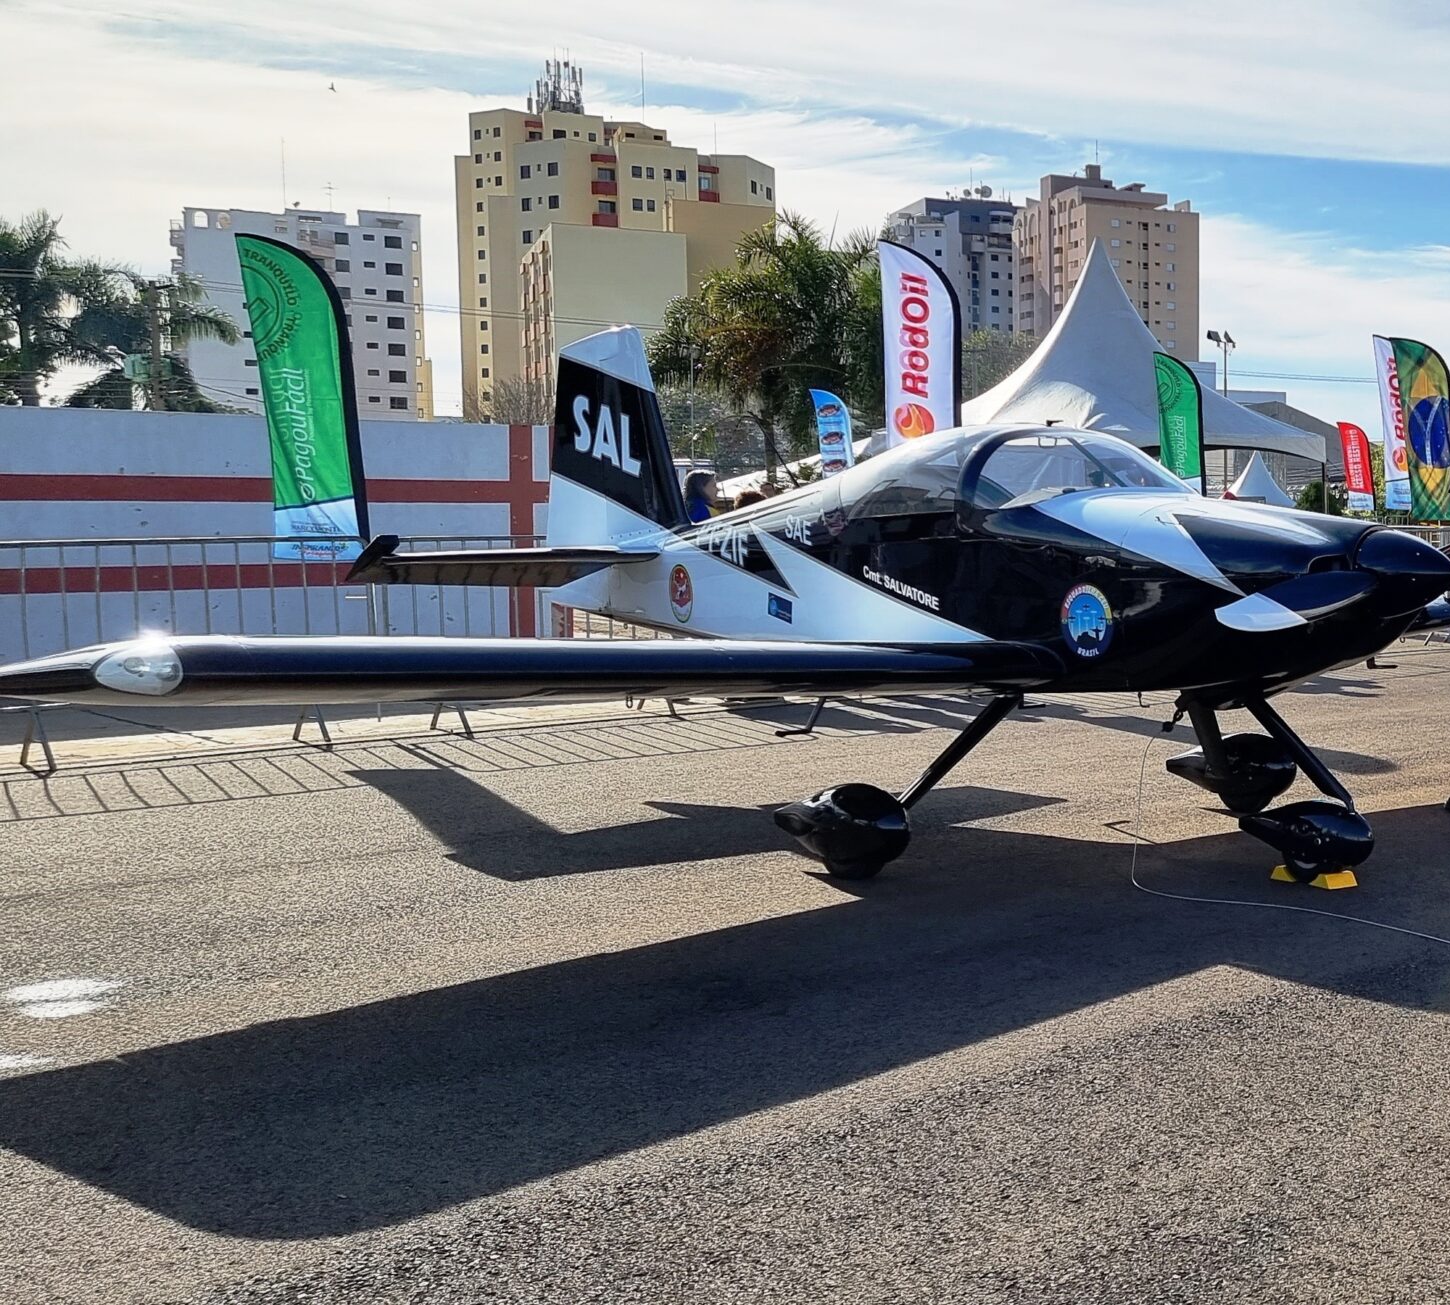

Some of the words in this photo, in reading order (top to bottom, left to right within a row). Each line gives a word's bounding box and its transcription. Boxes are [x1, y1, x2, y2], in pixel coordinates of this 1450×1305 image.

[573, 394, 642, 478] SAL
[785, 514, 813, 546] SAE
[883, 574, 940, 611] SALVATORE
[1077, 647, 1100, 657] BRASIL
